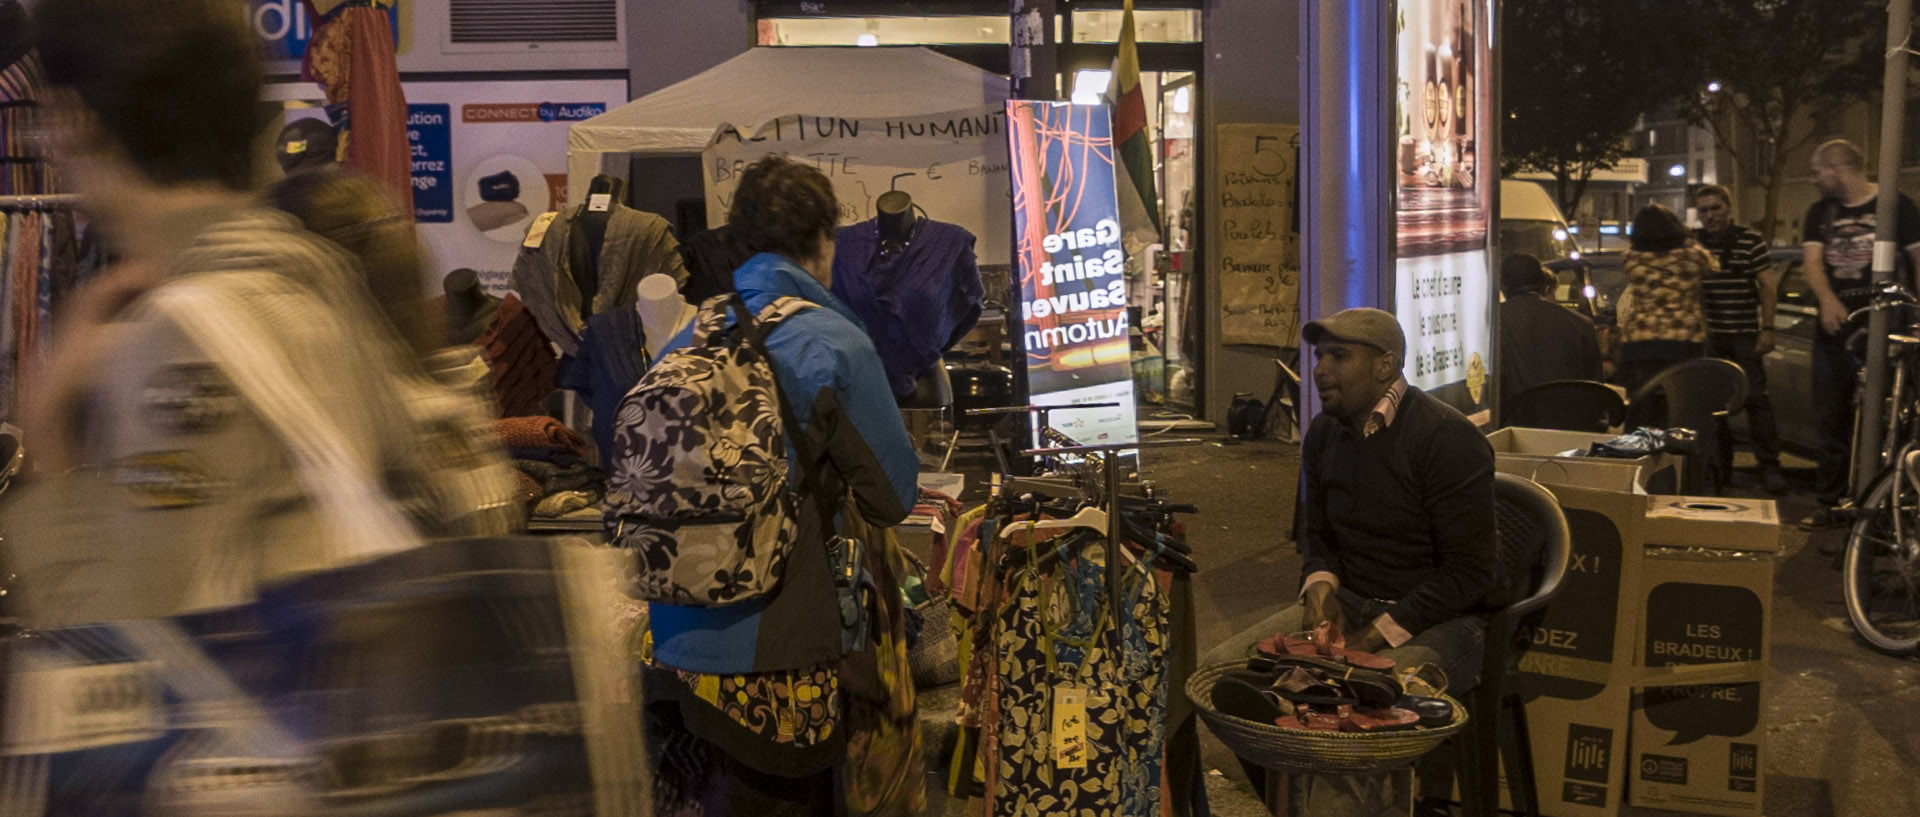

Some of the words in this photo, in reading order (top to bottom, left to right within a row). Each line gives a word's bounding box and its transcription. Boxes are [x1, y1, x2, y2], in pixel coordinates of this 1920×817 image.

[465, 108, 538, 119] CONNECT
[1252, 136, 1287, 177] 5
[926, 162, 942, 180] €
[1685, 623, 1722, 640] LES
[1653, 640, 1742, 662] BRADEUX
